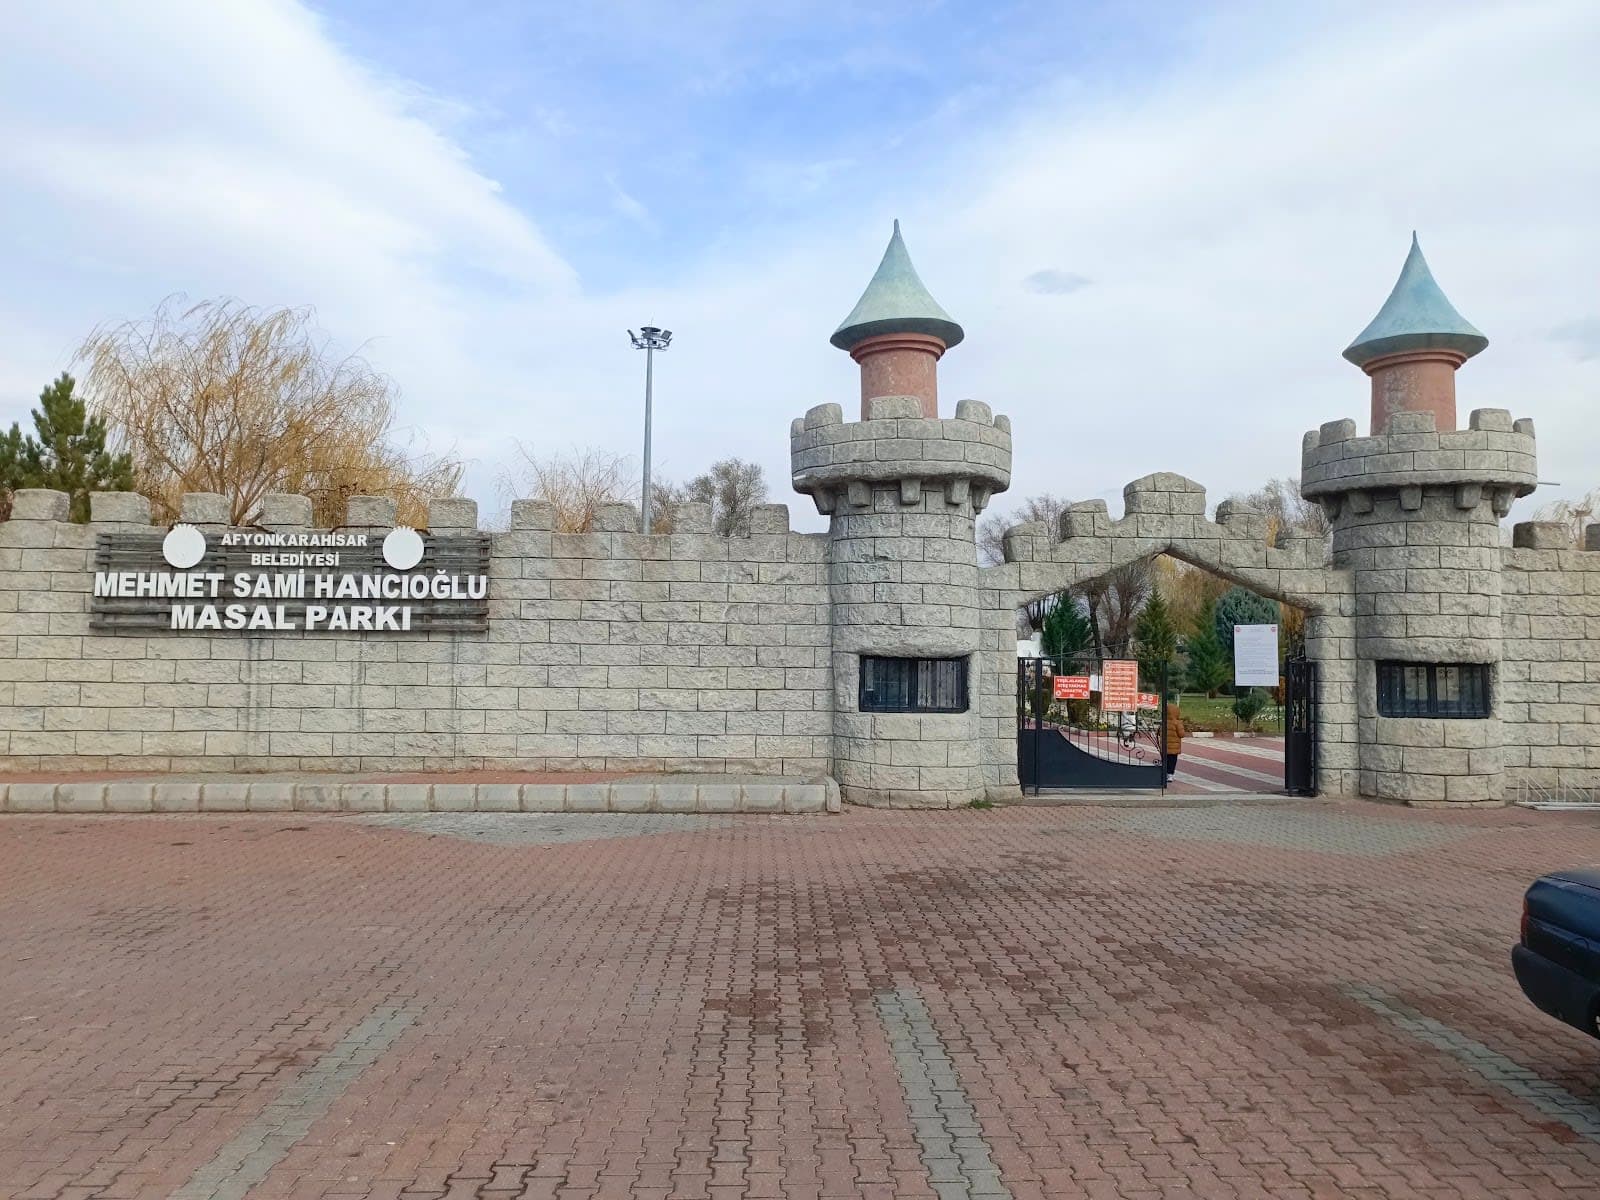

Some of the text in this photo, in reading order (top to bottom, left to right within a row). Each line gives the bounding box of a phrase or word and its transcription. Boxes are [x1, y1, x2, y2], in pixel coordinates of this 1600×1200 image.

[220, 532, 368, 547] AFYONKARAHİSAR
[251, 550, 340, 567] BELEDİYESİ
[94, 569, 488, 600] MEHMET SAMİ HANCIOĞLU
[170, 604, 412, 631] MASAL PARKI
